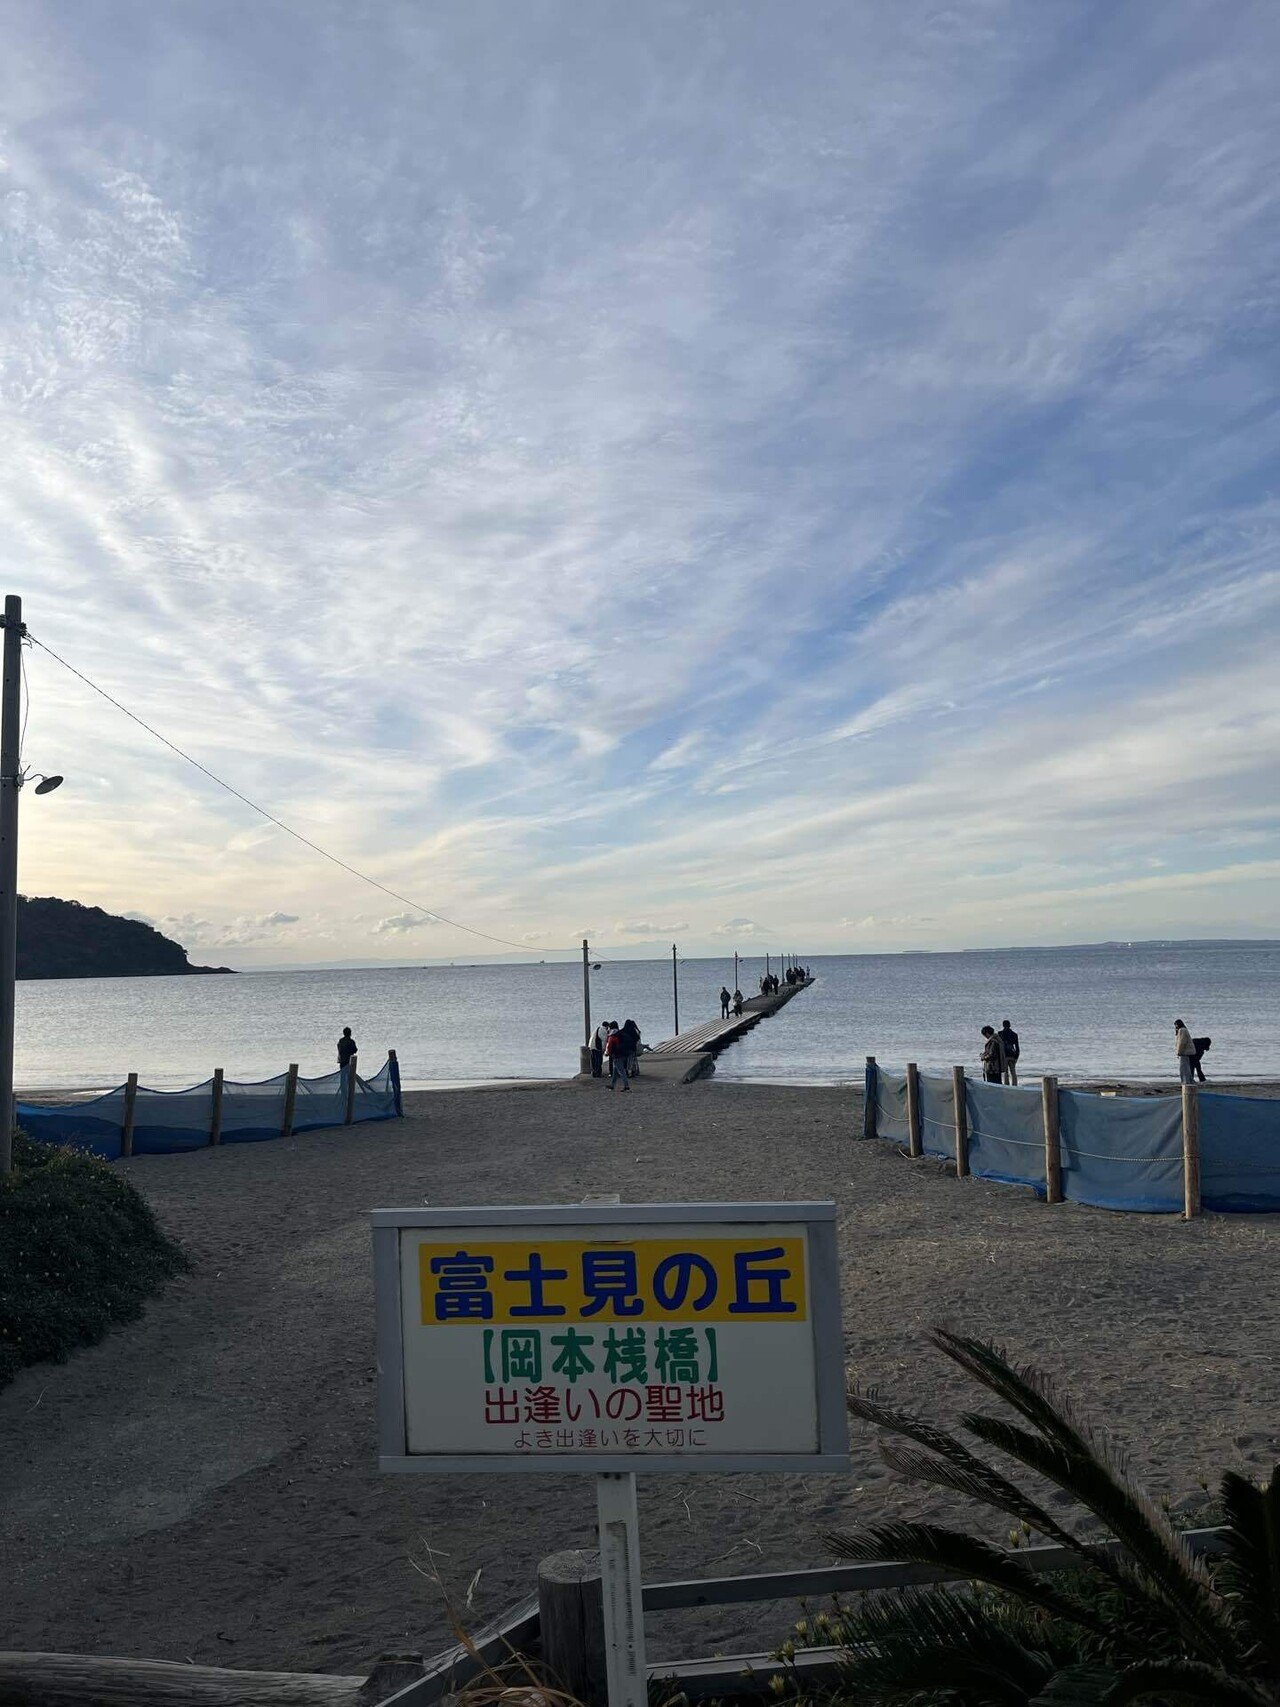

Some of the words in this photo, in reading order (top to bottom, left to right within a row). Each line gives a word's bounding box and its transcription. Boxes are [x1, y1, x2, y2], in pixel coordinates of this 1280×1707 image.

[430, 1247, 797, 1320] 富士見の丘
[483, 1326, 718, 1384] 【岡本桟橋】
[485, 1384, 725, 1425] 出逢いの聖地
[514, 1428, 707, 1449] よき出逢いを大切に
